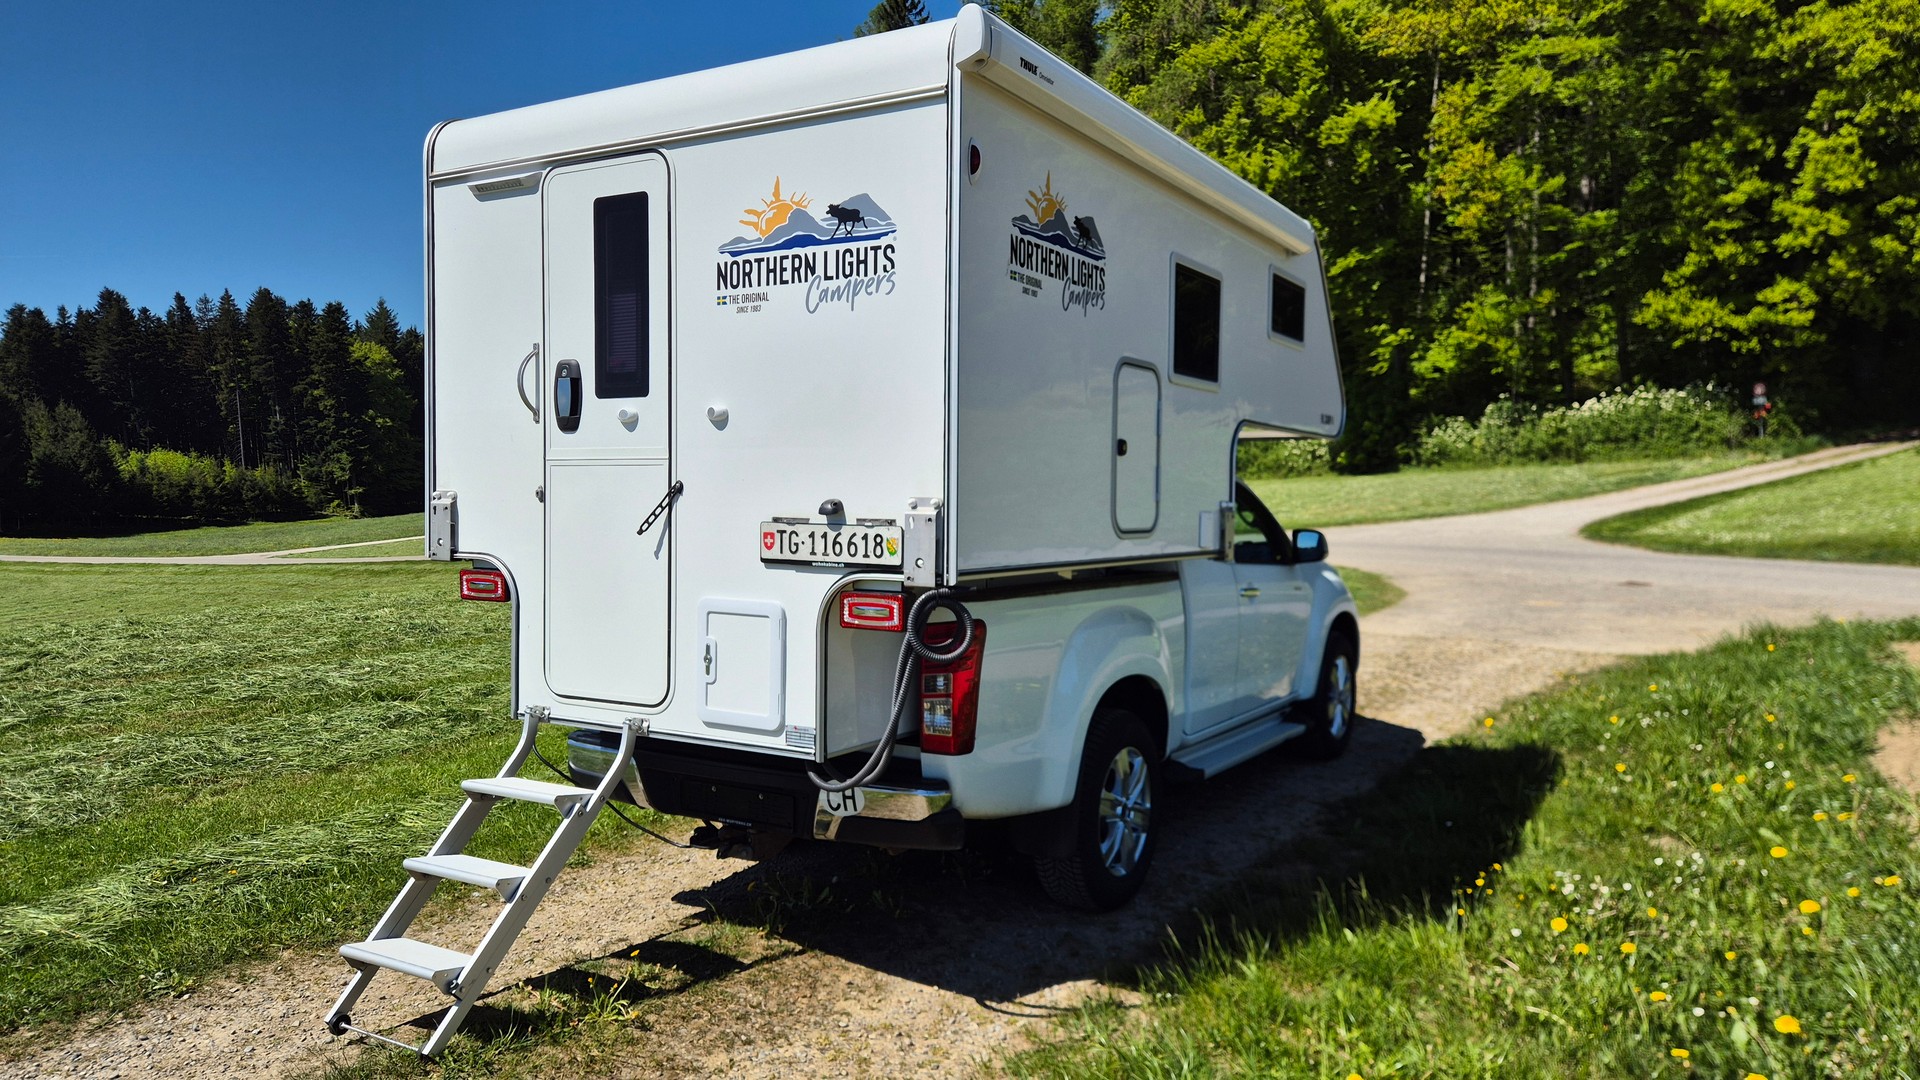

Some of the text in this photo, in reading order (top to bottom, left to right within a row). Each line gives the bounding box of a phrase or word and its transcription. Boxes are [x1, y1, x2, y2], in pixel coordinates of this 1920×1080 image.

[1020, 56, 1038, 76] THULE
[717, 244, 896, 291] NORTHERN LIGHTS
[1010, 234, 1105, 292] NORTHERN LIGHTS
[729, 292, 769, 304] THE ORIGINAL
[805, 271, 896, 314] Campers
[1062, 277, 1105, 317] Campers
[736, 304, 762, 314] SINCE 1983
[827, 786, 857, 811] CH
